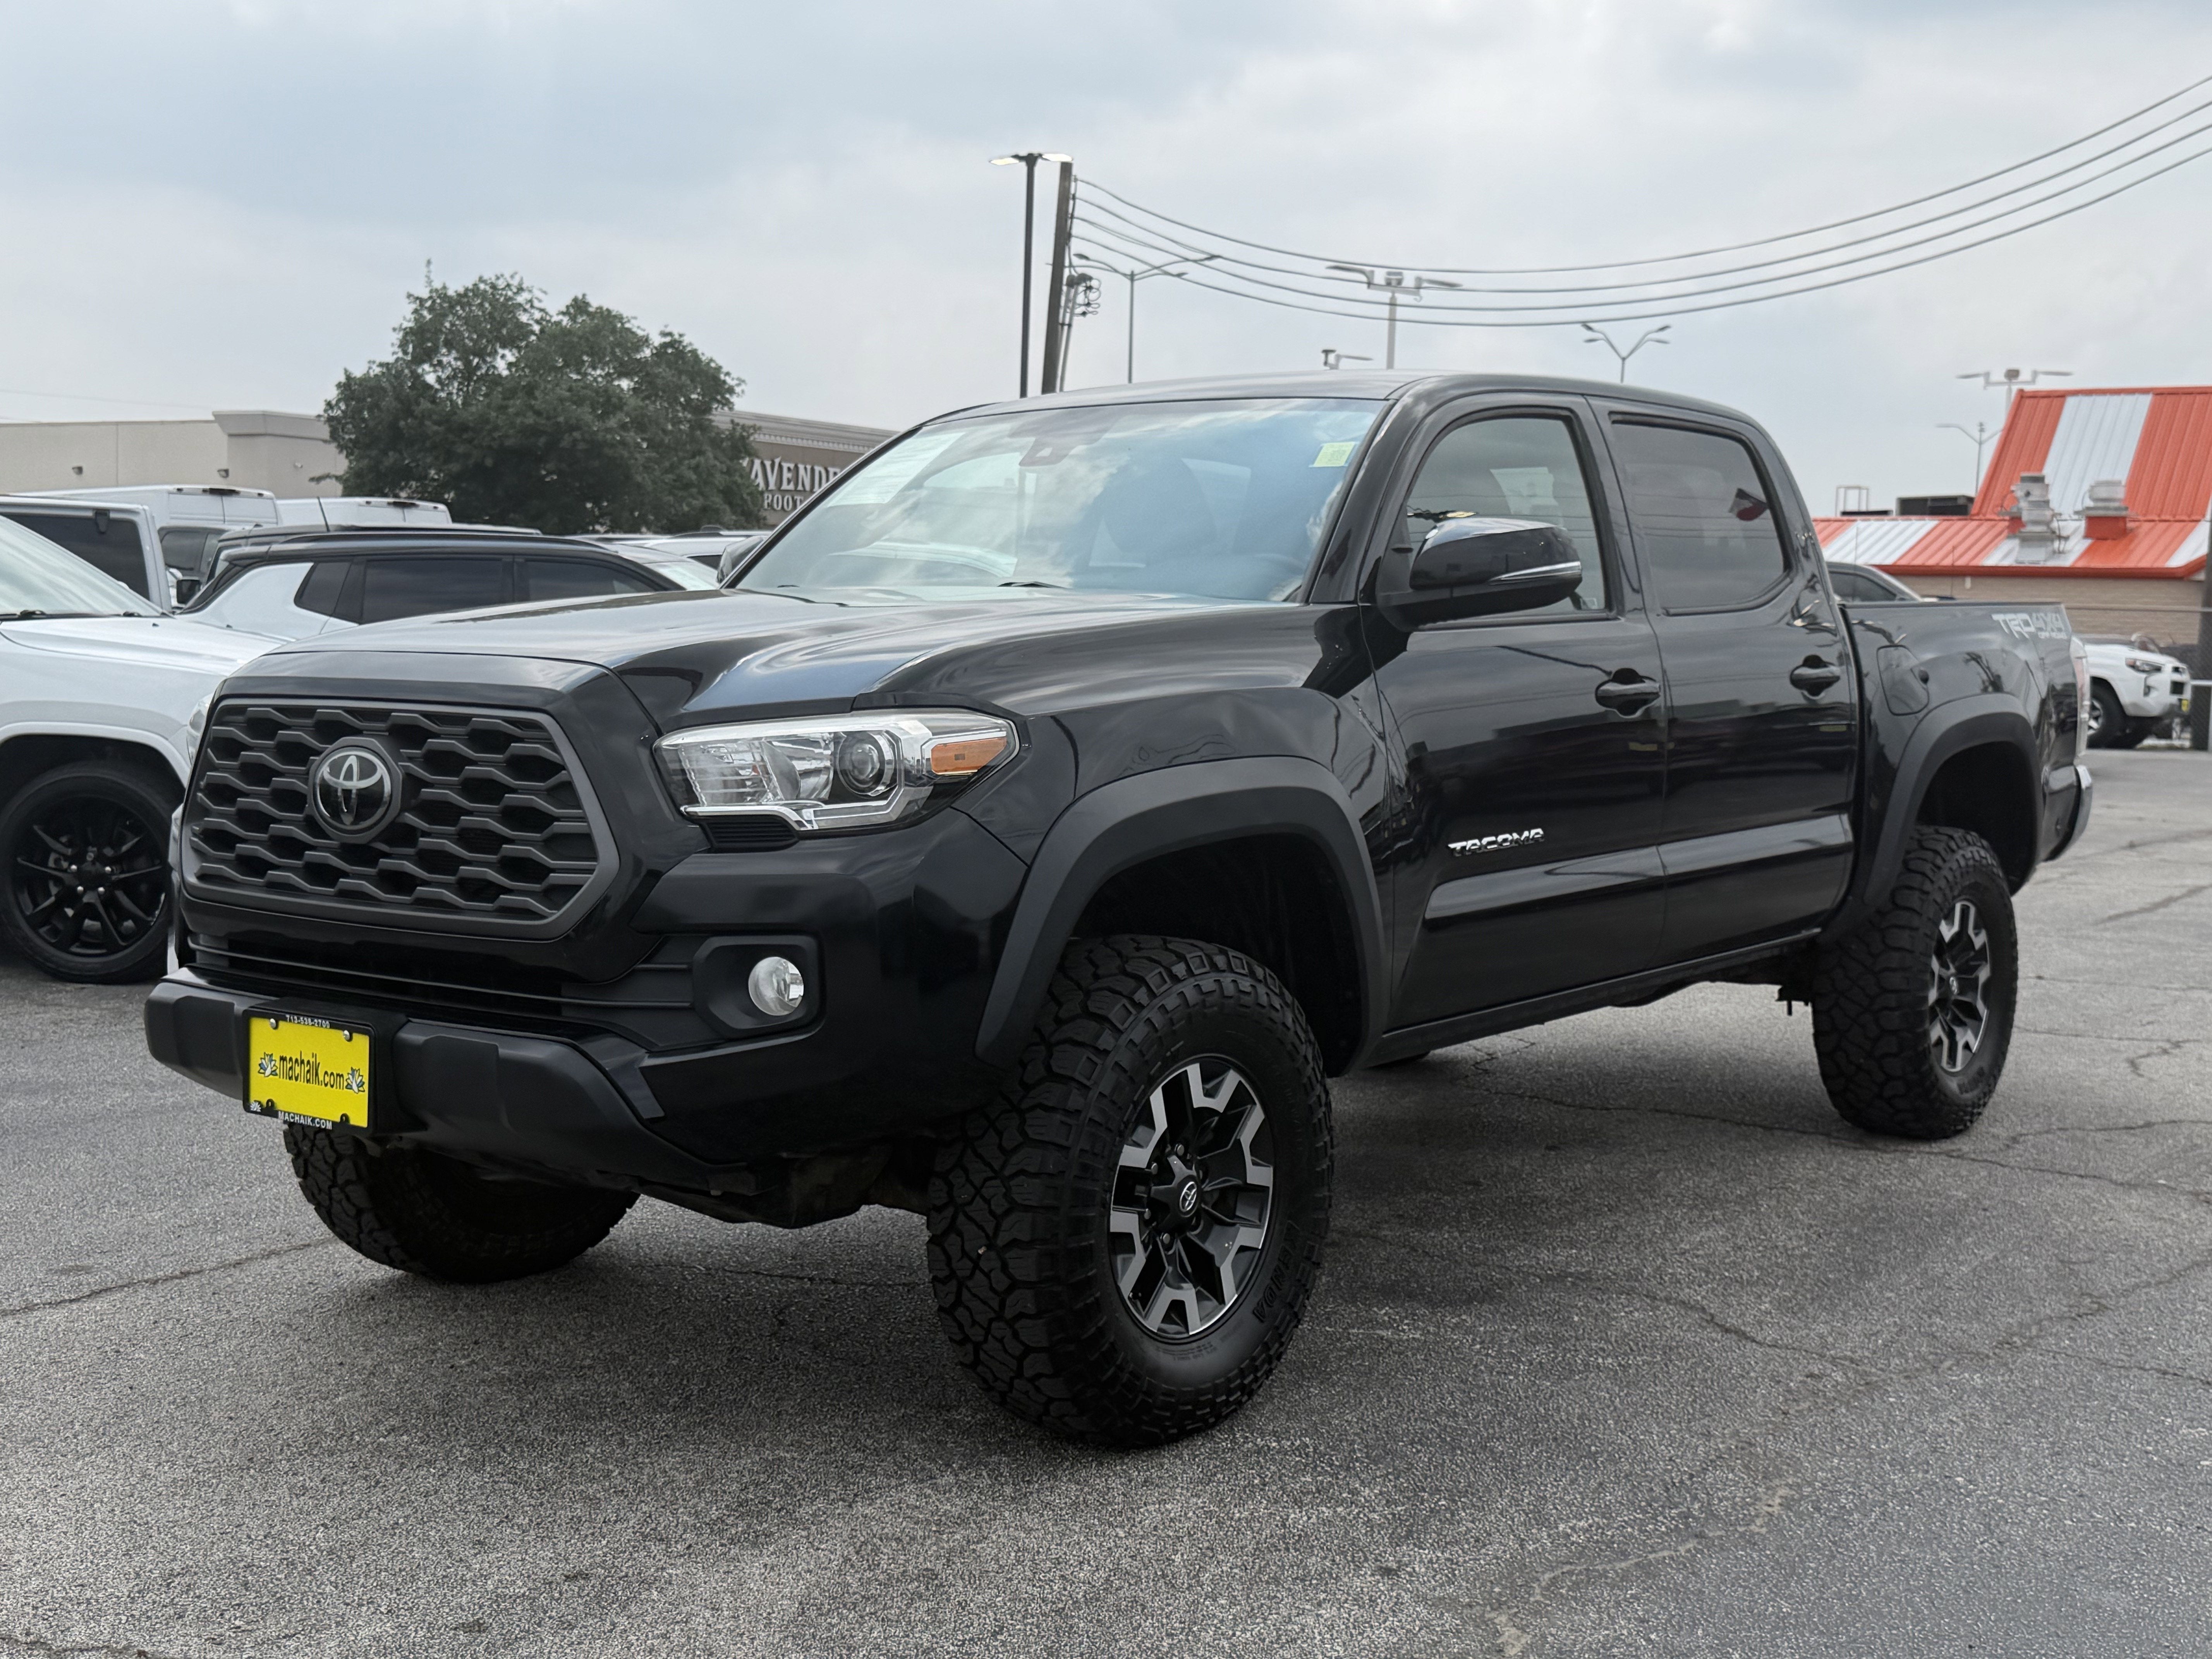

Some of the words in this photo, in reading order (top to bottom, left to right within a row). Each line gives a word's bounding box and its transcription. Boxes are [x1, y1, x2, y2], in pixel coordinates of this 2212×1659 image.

[1991, 613, 2036, 639] TRD
[1448, 828, 1545, 857] TACOMA
[279, 1050, 344, 1090] machaik.com
[278, 1111, 332, 1130] MACHAIK.COM
